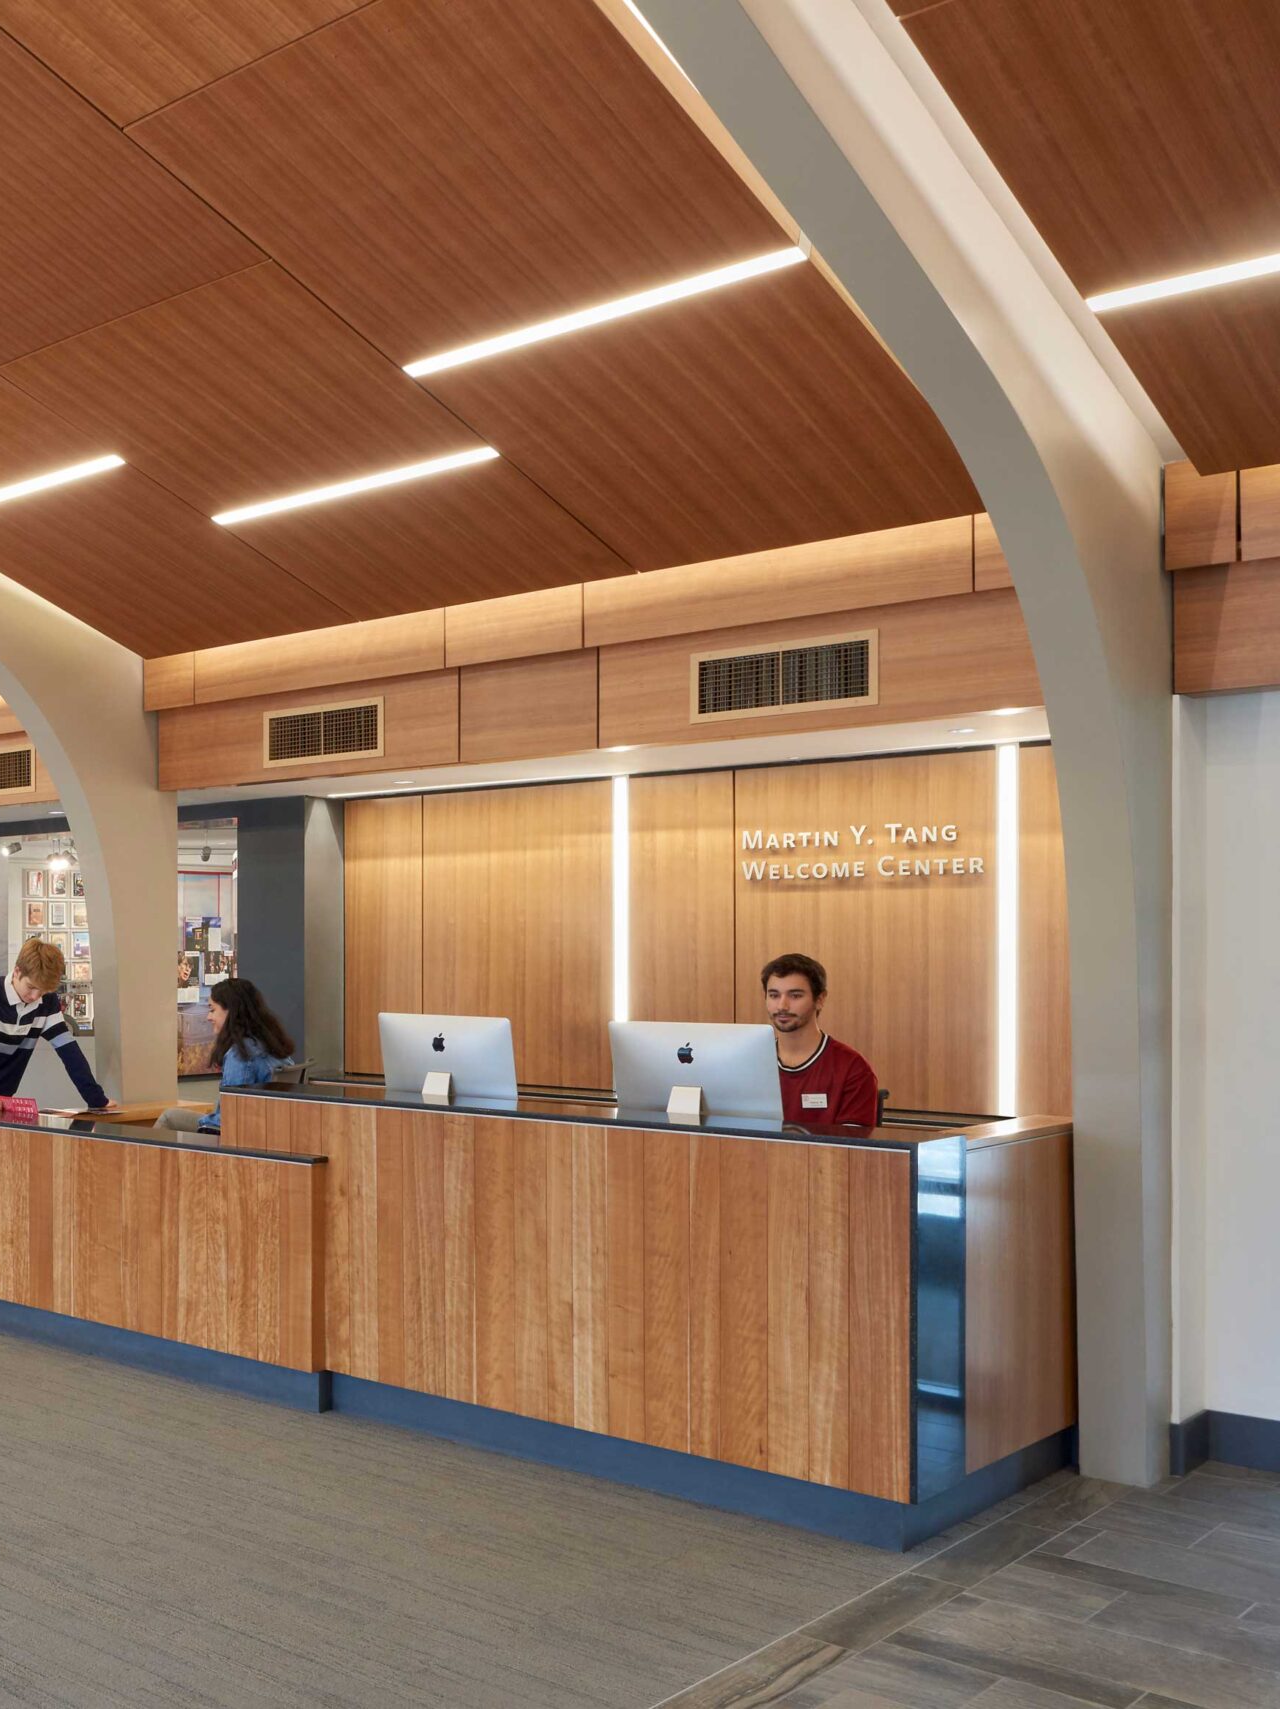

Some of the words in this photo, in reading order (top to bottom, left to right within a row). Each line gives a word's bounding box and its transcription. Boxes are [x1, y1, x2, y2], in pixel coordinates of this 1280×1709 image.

[741, 829, 839, 850] MARTIN
[849, 824, 874, 845] Y.
[884, 823, 958, 844] TANG
[741, 860, 866, 881] WELCOME
[877, 855, 985, 877] CENTER
